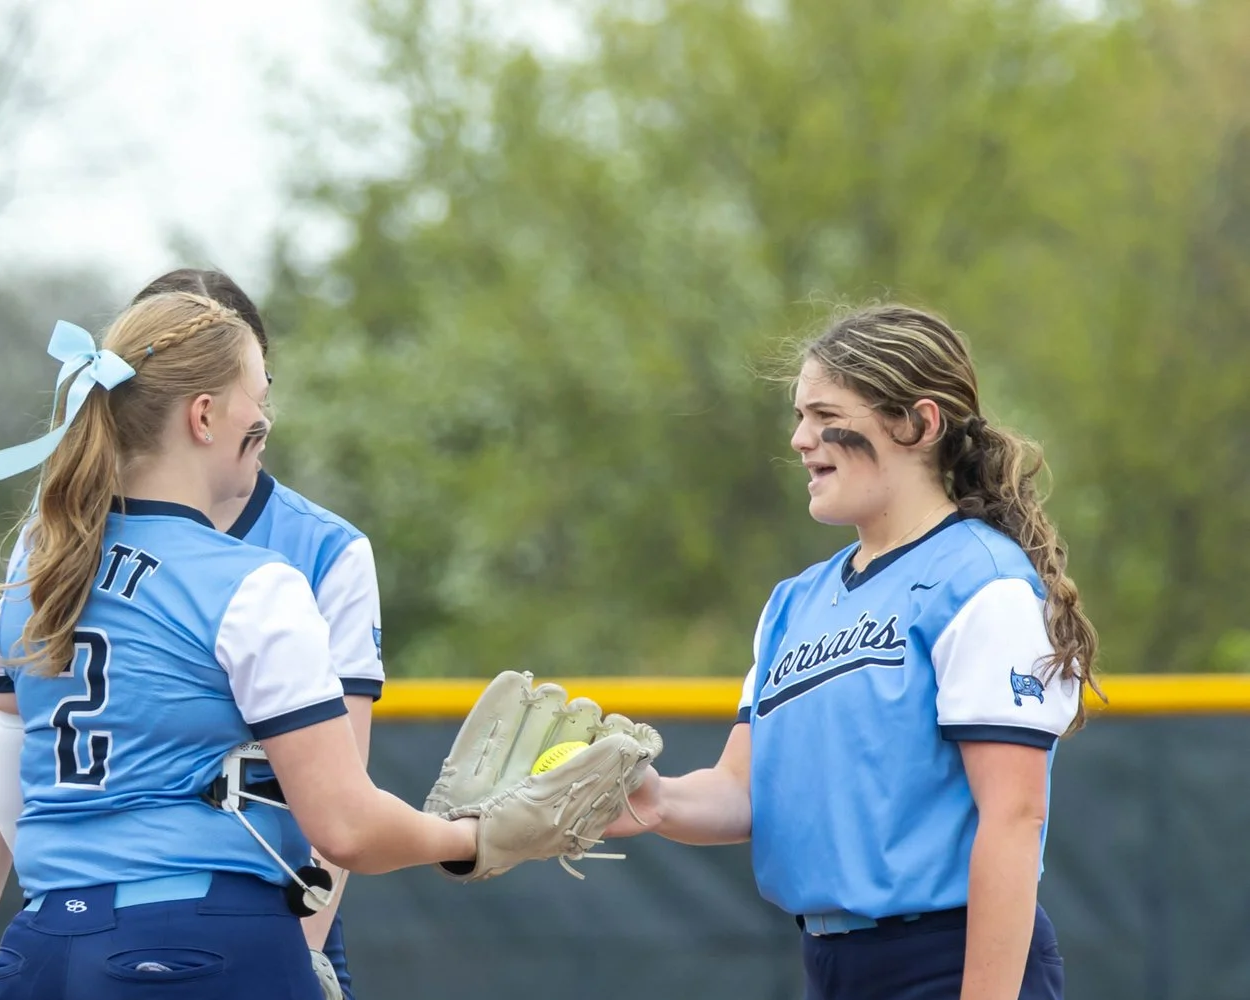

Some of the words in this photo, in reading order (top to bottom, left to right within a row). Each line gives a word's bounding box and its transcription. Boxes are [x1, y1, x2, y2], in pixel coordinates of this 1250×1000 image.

[97, 542, 162, 601] TT
[761, 611, 906, 692] orsairs
[50, 627, 112, 791] 2
